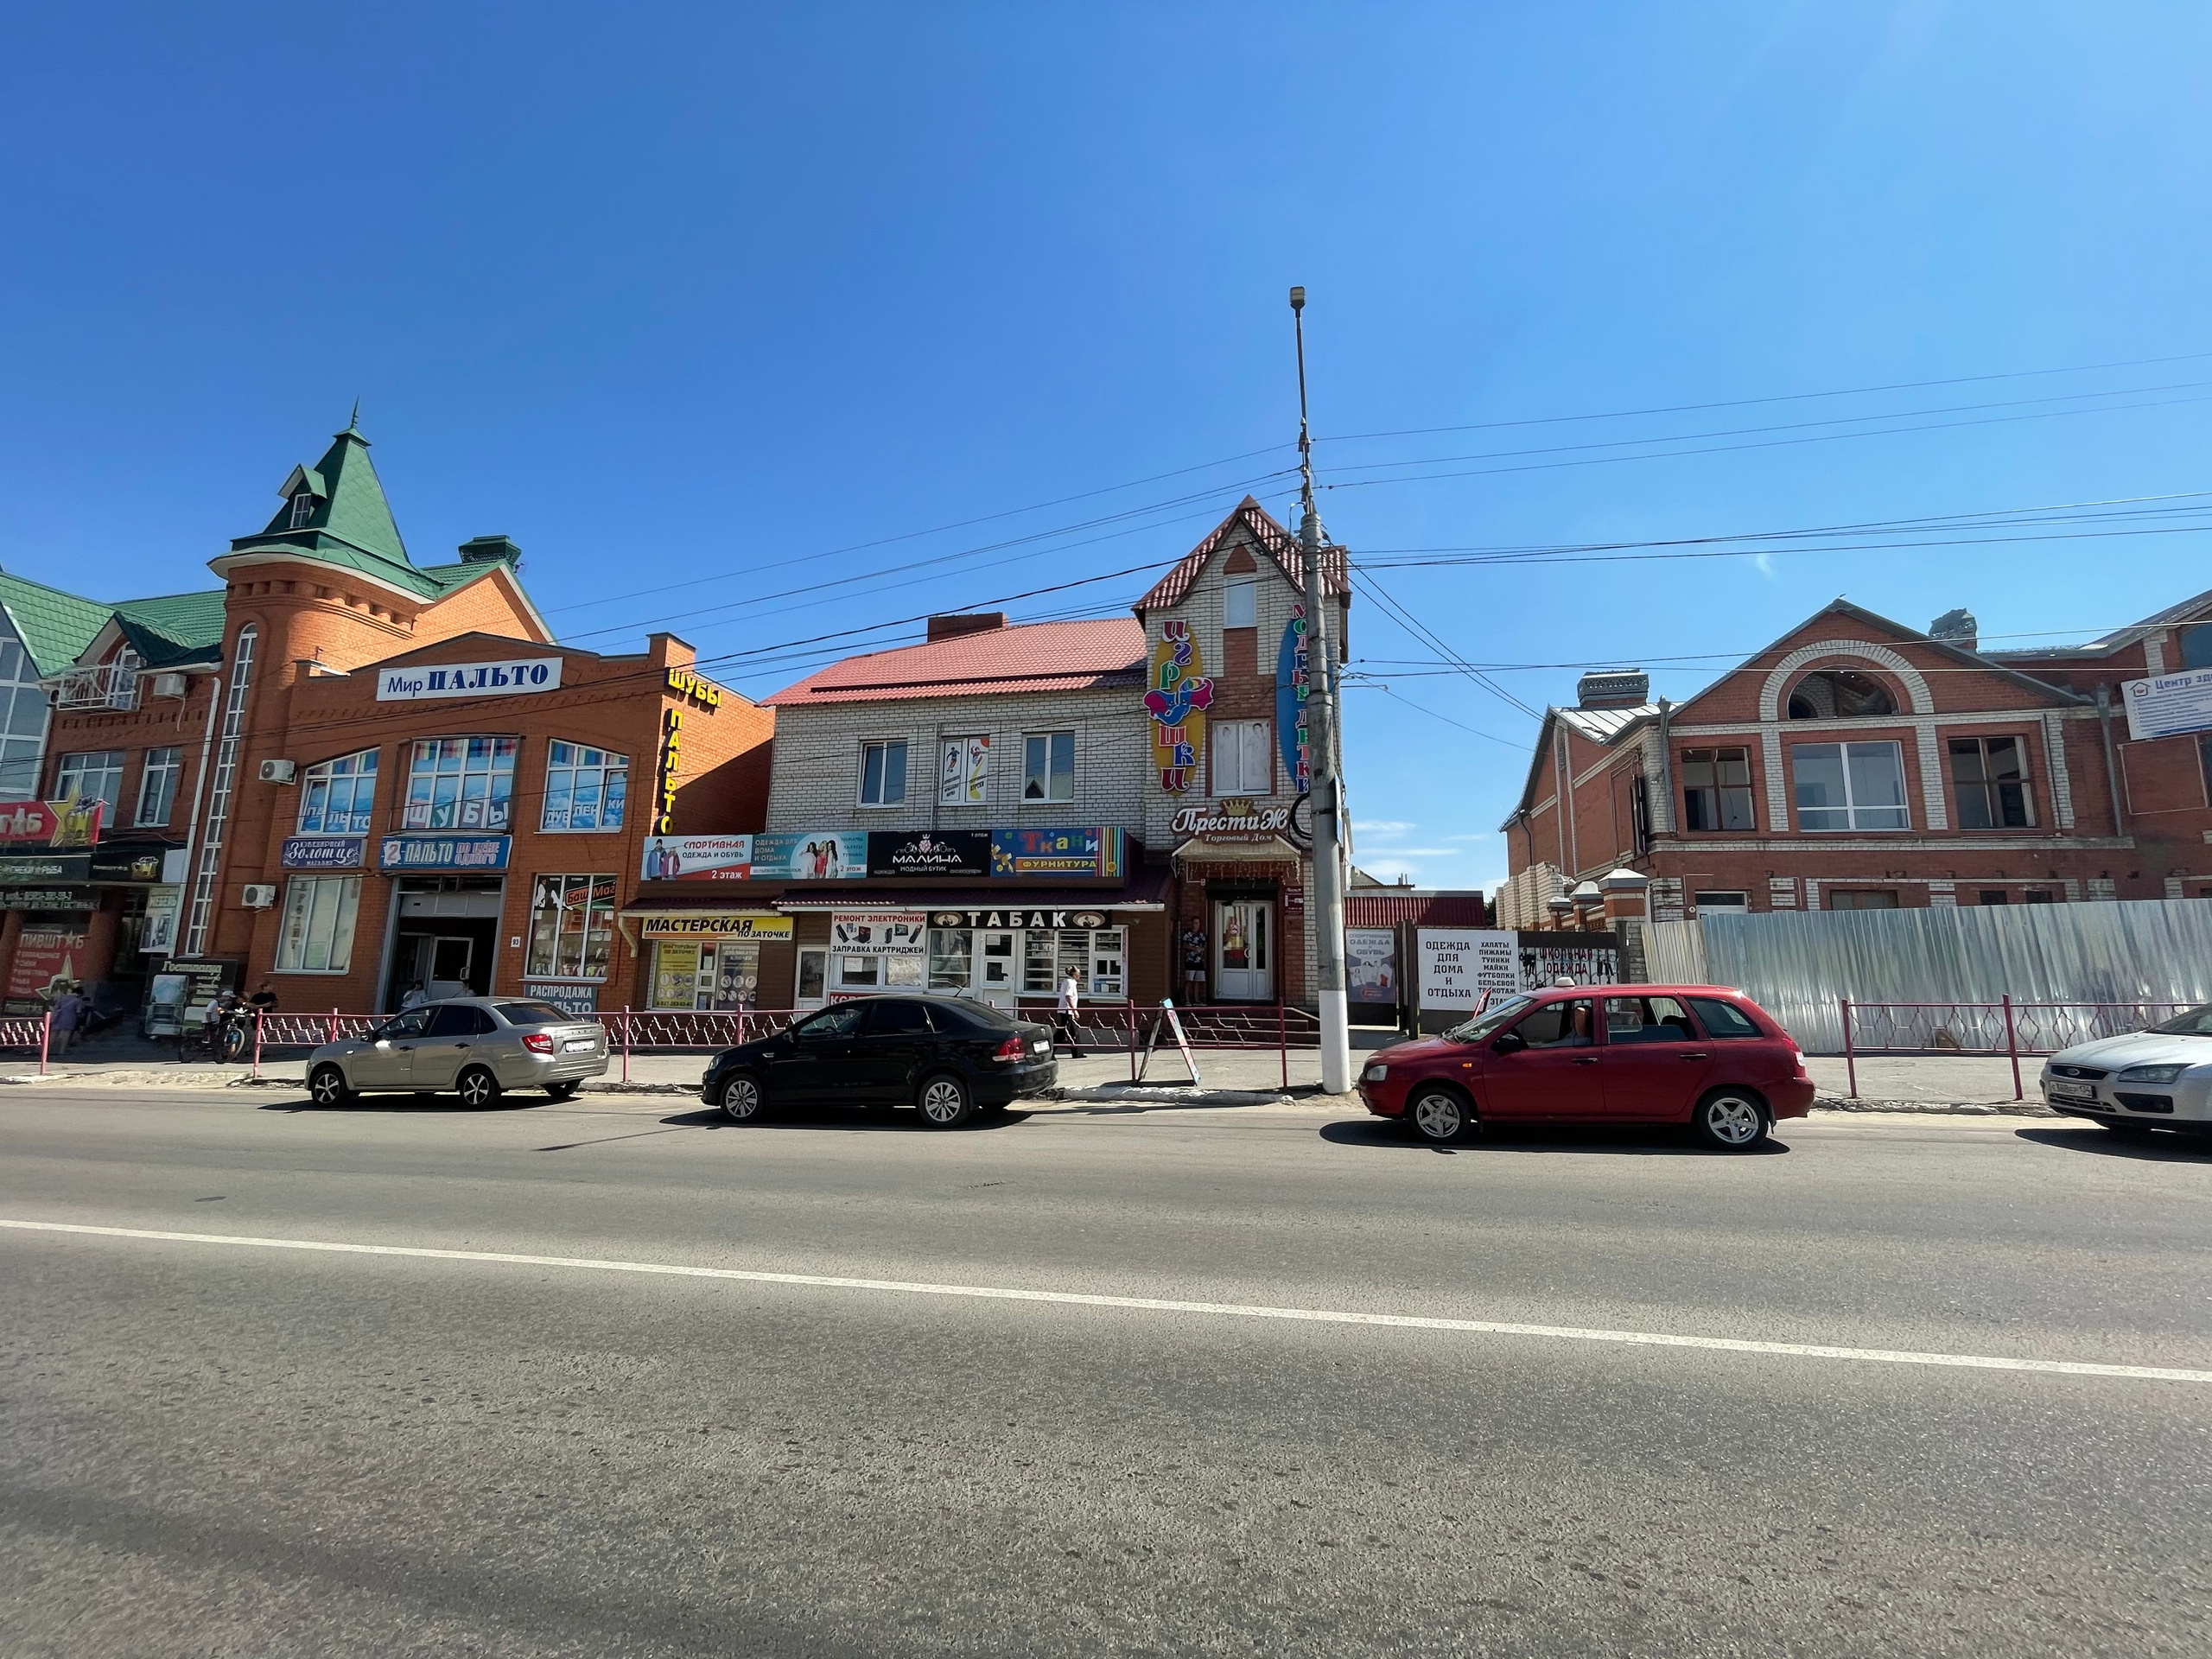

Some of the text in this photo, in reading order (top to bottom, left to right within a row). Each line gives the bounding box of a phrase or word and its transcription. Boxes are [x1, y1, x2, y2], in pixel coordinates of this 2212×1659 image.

[387, 664, 549, 696] Мир ПАЛЬТО
[2155, 674, 2212, 690] Центр зд
[668, 668, 722, 708] ШУБЫ
[660, 709, 684, 835] ПАЛЬТО
[409, 801, 510, 826] ШУБЫ
[1251, 834, 1272, 842] Дом
[683, 840, 745, 849] СПОРТИВНАЯ
[387, 842, 454, 865] 2 ПАЛЬТО
[682, 851, 712, 860] ОДЕЖДА
[893, 855, 963, 864] МАЛИНА
[1021, 860, 1097, 868] ФУРНИТУРА
[900, 864, 927, 873] МОДНЫЙ
[711, 870, 743, 880] 2 этаж
[868, 914, 925, 923] ЭЛЕКТРОНИКИ
[967, 912, 1067, 927] ТАБАК
[645, 918, 753, 932] МАСТЕРСКАЯ
[872, 945, 924, 954] КАРТРИДЖЕЙ
[1426, 941, 1471, 951] ОДЕЖДА
[1437, 953, 1459, 963] ДЛЯ
[1539, 947, 1593, 960] ШКОЛЬНАЯ
[1433, 964, 1464, 974] ДОМА
[1546, 962, 1588, 976] ОДЕЖДА
[1446, 976, 1452, 985] И
[530, 984, 593, 1000] РАСПРОДАЖА
[1427, 988, 1471, 998] ОТДЫХА
